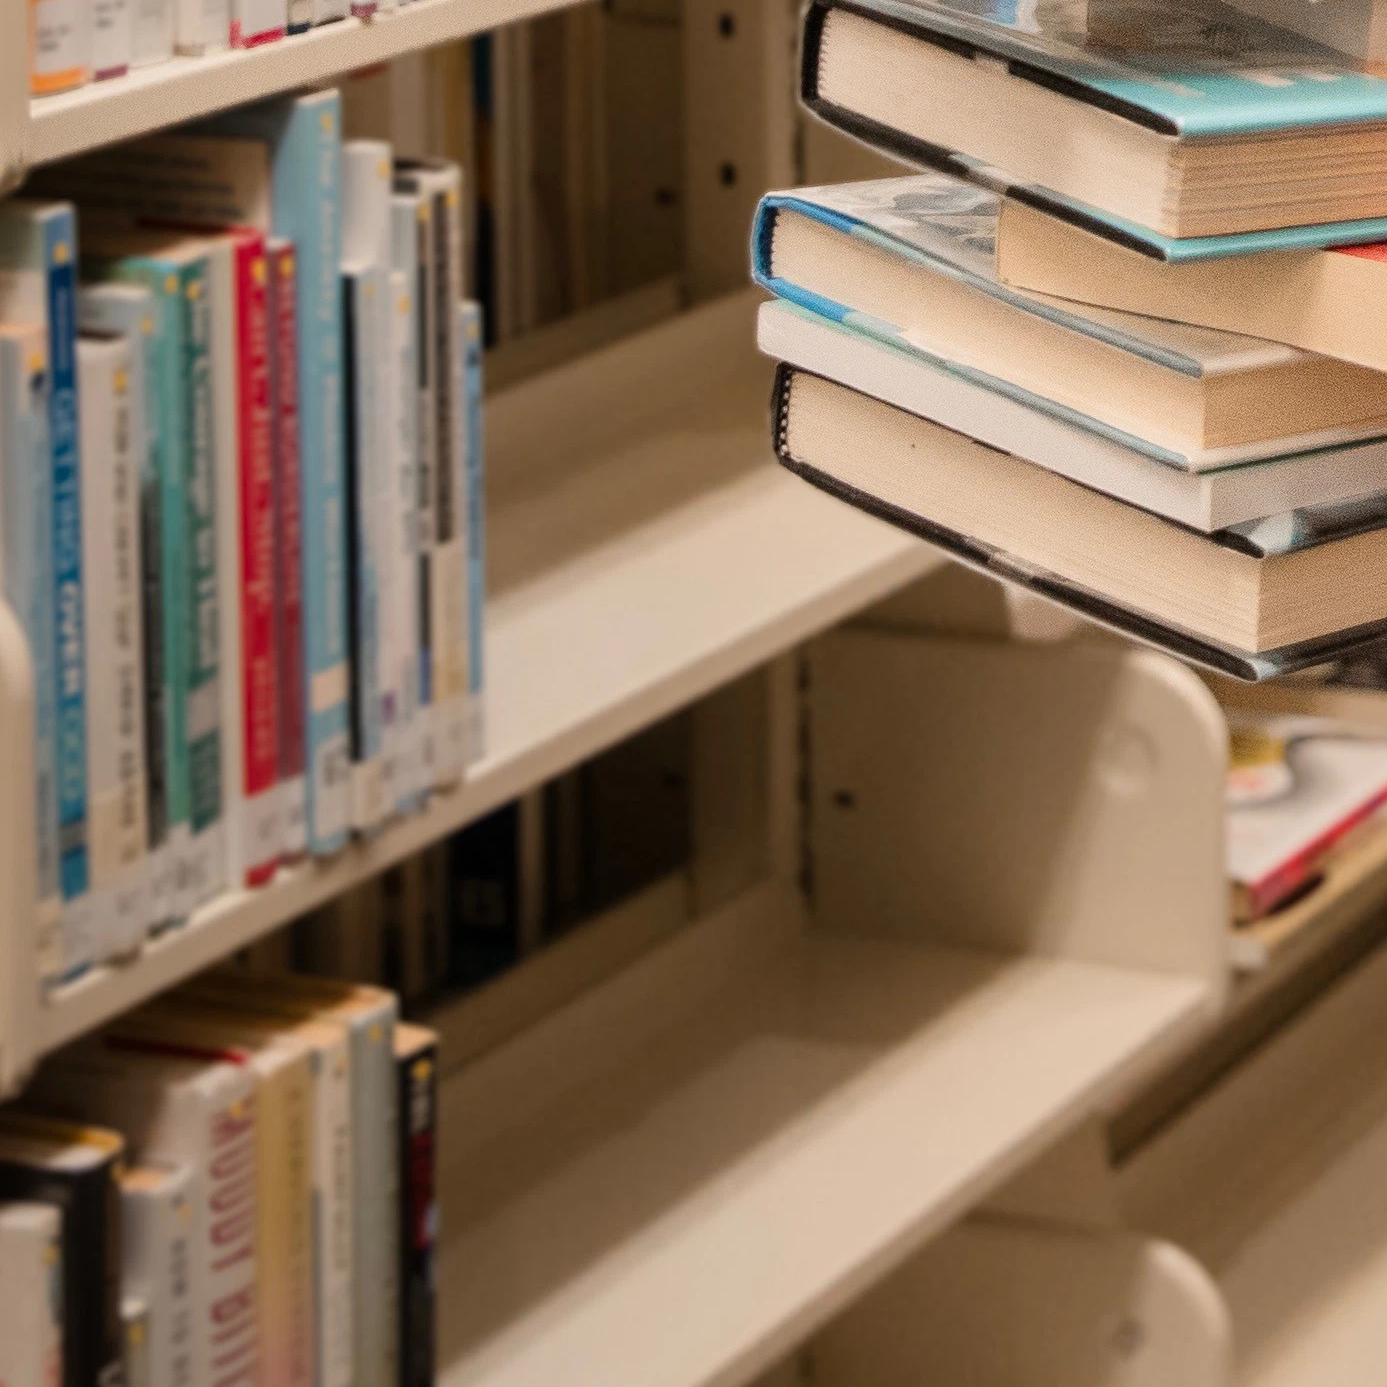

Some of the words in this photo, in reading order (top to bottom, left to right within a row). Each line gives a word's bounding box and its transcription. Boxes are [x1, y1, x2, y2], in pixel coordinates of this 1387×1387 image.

[57, 389, 80, 571] GETTING
[60, 582, 83, 696] OVER
[61, 708, 85, 804] OCD
